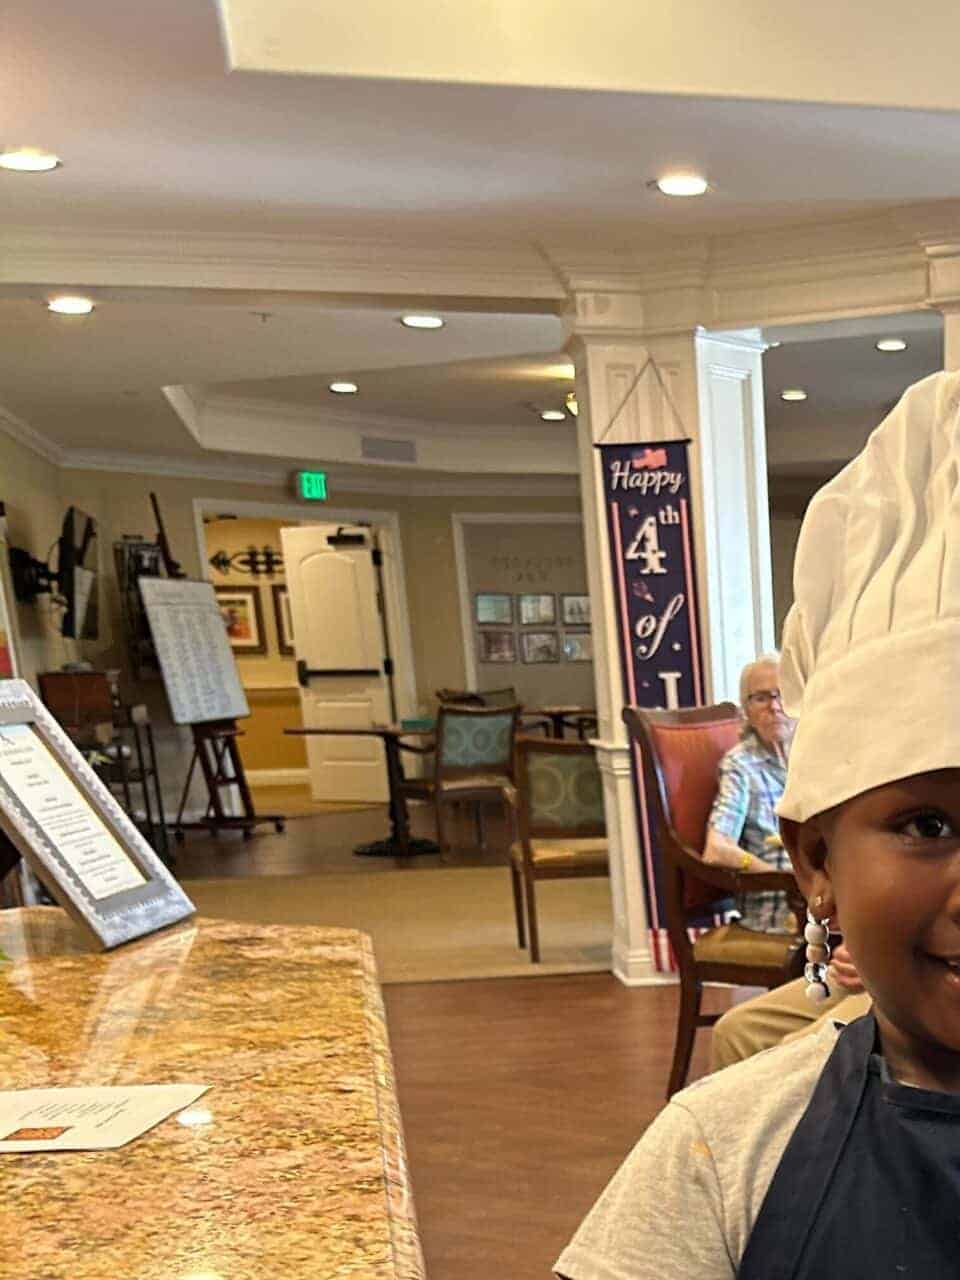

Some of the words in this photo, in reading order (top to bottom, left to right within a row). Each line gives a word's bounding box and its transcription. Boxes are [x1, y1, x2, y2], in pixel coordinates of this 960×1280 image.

[610, 460, 685, 494] Happy
[625, 505, 681, 575] 4th
[636, 594, 685, 659] of
